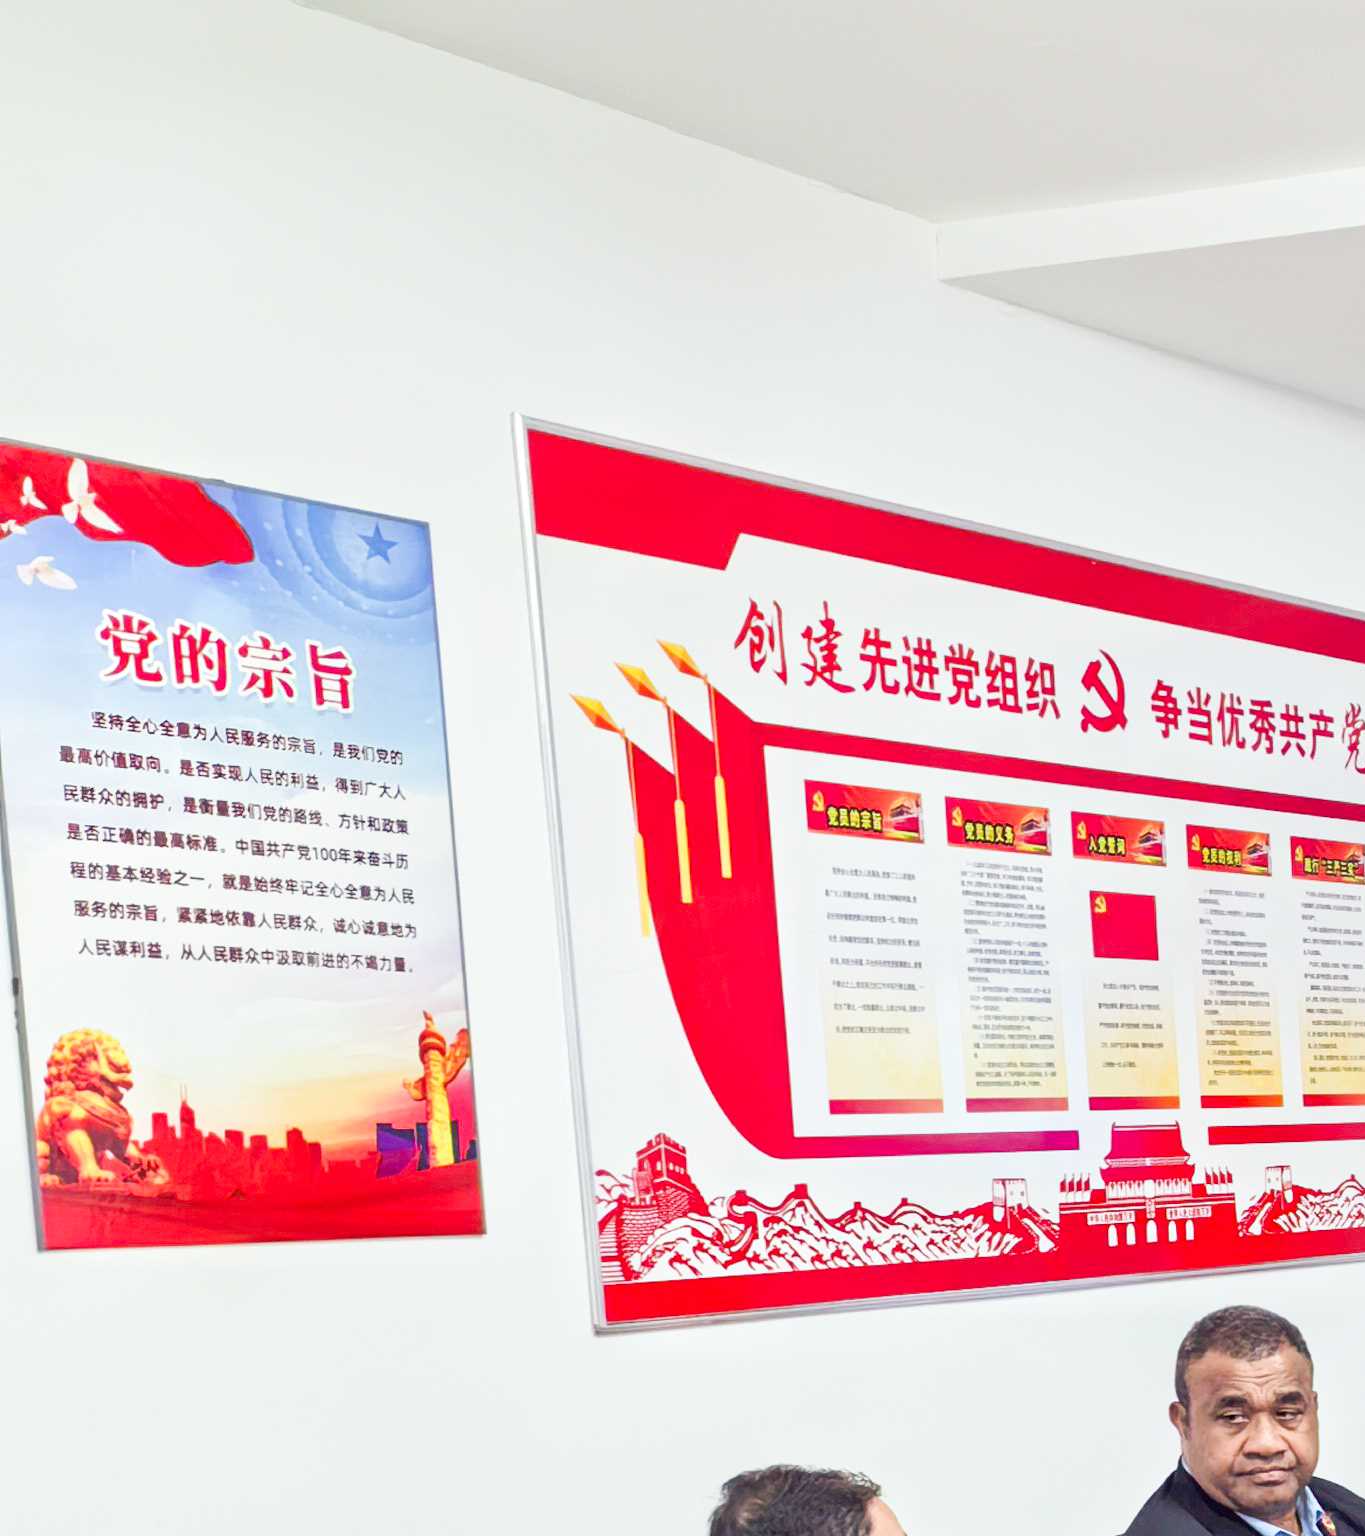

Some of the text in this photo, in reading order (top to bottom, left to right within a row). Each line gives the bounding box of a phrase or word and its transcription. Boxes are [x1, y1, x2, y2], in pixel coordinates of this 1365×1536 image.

[101, 612, 353, 710] 党的宗旨
[734, 598, 1062, 720] 创建先进党组织
[91, 711, 404, 766] 坚持全心全意为人民服务的宗旨，是我们党的
[59, 745, 407, 800] 最高价值取向。是否实现人民的利益，得到广大人
[63, 784, 410, 835] 民群众的拥护，是衡量我们党的路线、方针和政策
[66, 822, 410, 870] 是否正确的最高标准。中国共产党100年来奋斗历
[69, 861, 415, 905] 程的基本经验之一，就是始终牢记全心全意为人民
[73, 899, 418, 939] 服务的宗旨，紧紧地依靠人民群众，诚心诚意地为
[77, 938, 415, 974] 人民谋利益，从人民群众中汲取前进的不竭力量。
